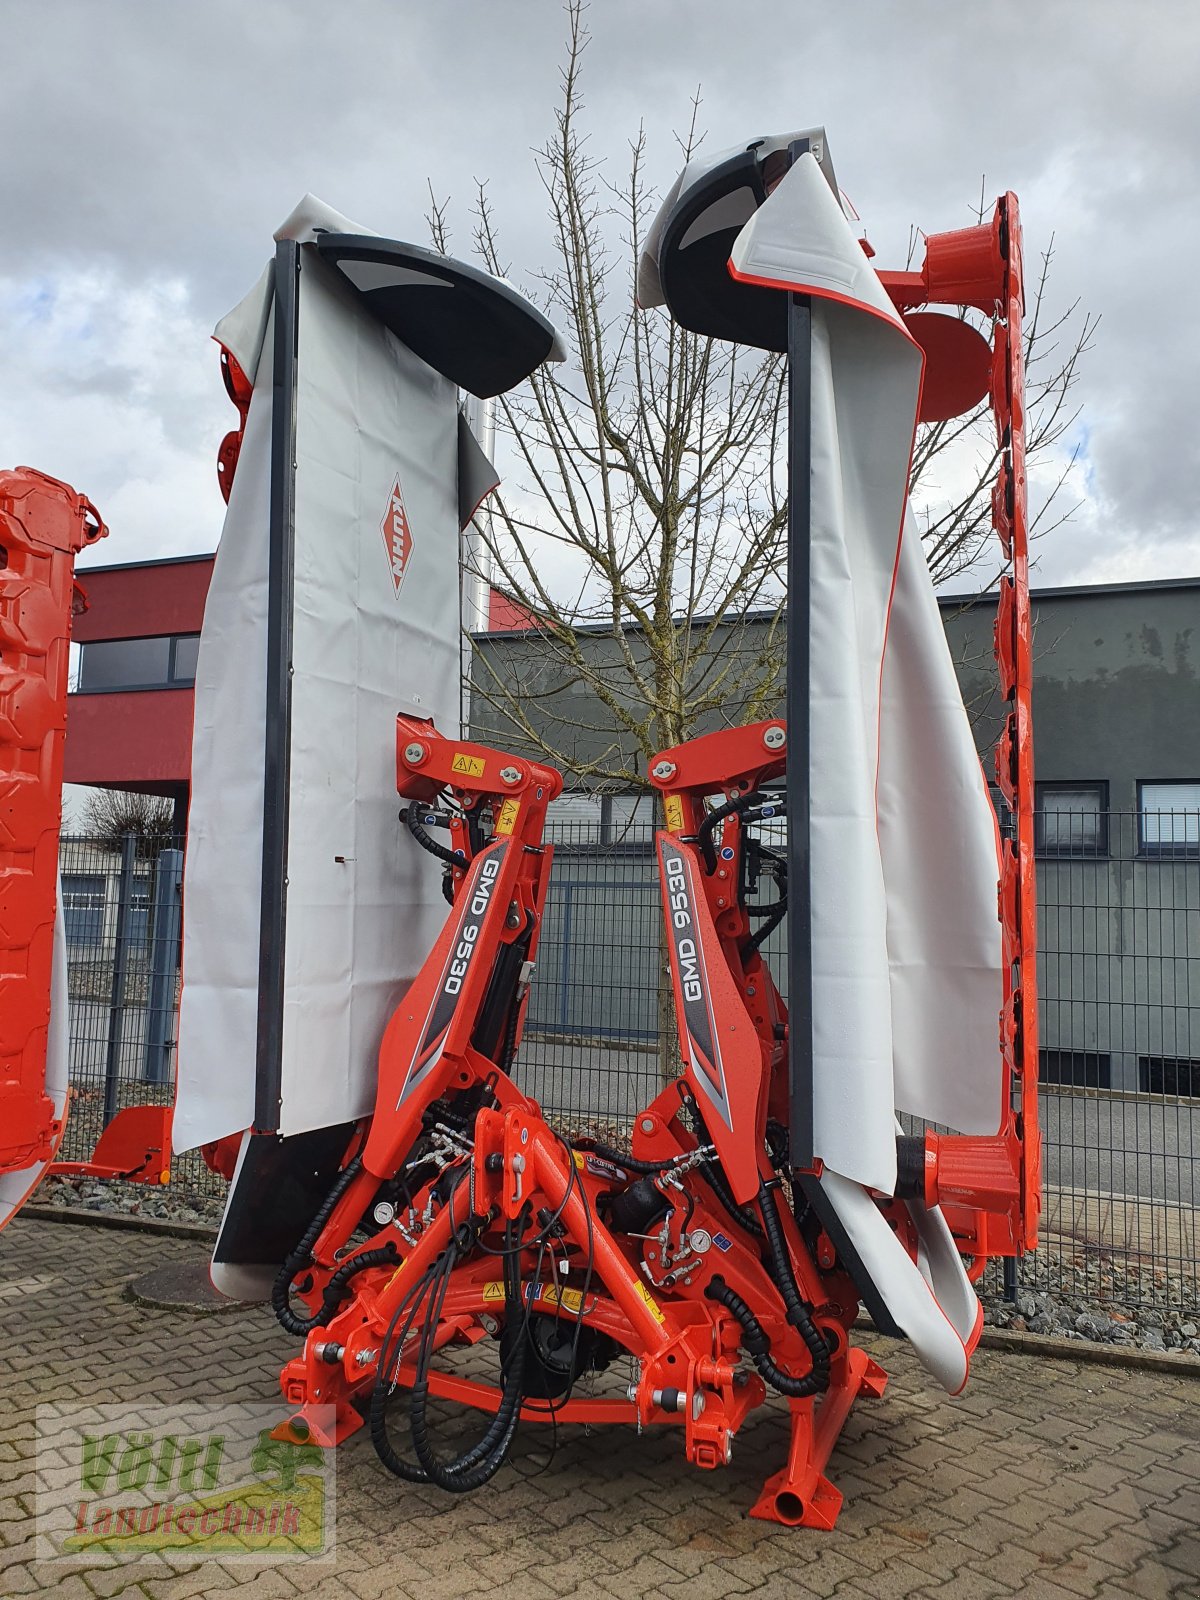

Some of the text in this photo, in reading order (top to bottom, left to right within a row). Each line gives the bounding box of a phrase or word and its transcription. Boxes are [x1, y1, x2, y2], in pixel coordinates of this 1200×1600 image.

[392, 494, 404, 578] KUHN
[444, 859, 500, 995] GMD 9530
[666, 857, 702, 1002] GMD 9530
